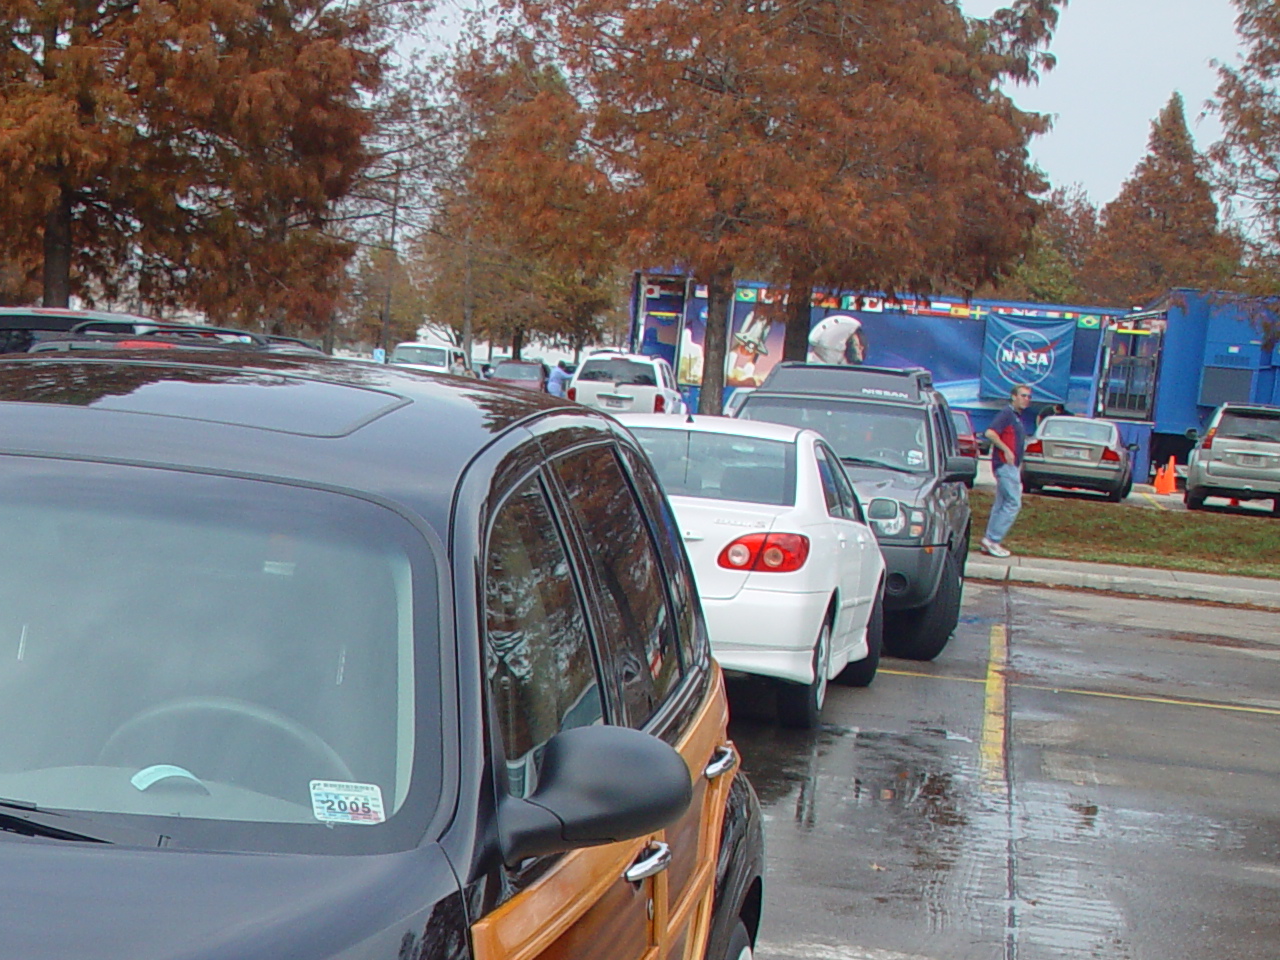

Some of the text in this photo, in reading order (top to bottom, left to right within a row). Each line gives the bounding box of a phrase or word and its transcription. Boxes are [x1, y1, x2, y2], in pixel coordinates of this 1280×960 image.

[1001, 349, 1049, 365] NASA
[861, 387, 909, 399] NISSAN
[325, 799, 372, 814] 2005
